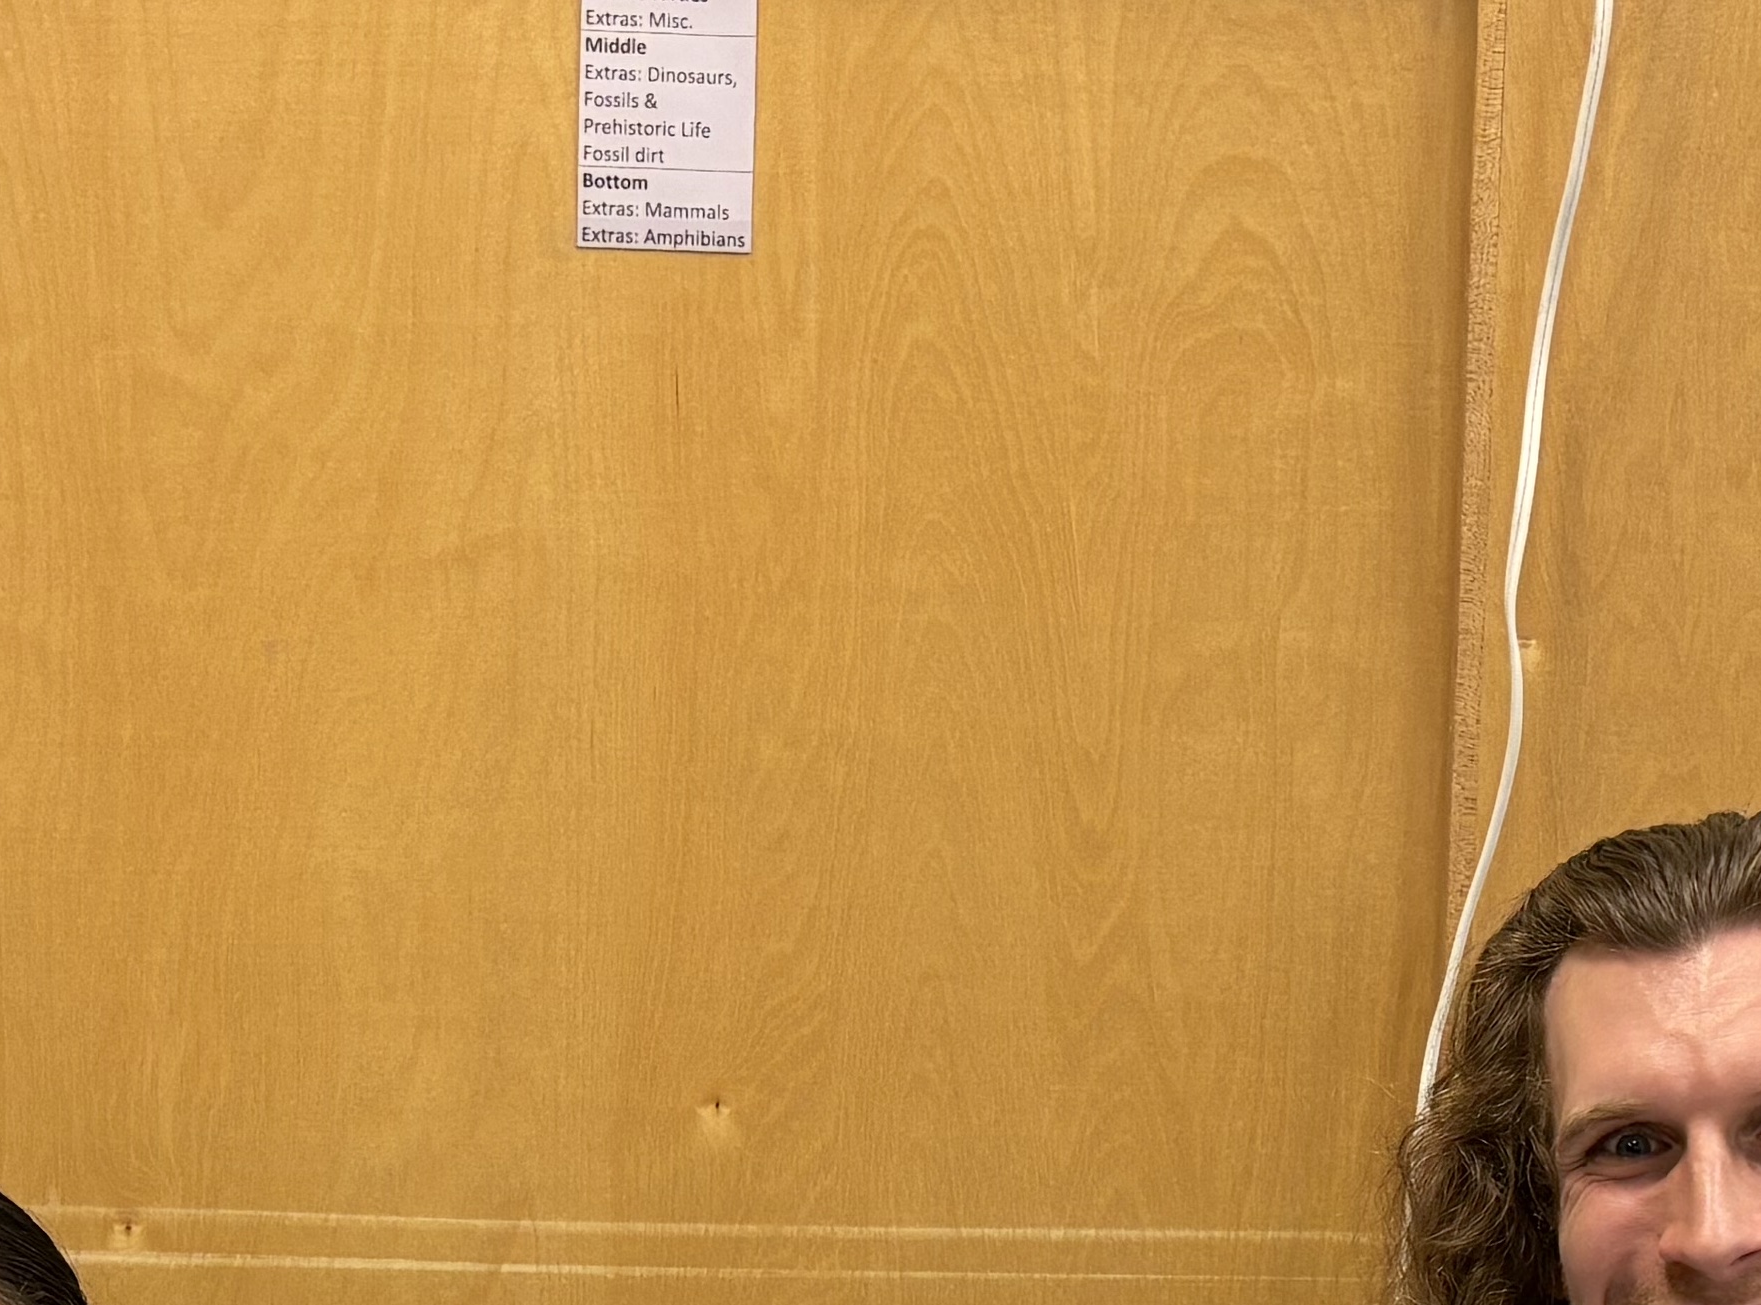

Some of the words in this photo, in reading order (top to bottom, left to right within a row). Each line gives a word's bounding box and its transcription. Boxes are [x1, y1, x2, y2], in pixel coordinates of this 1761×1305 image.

[585, 10, 643, 27] Extras:
[649, 12, 693, 29] Misc.
[585, 37, 647, 55] Middle
[584, 65, 642, 82] Extras:
[648, 67, 737, 88] Dinosaurs,
[584, 92, 639, 109] Fossils
[644, 93, 658, 109] &
[583, 118, 675, 137] Prehistoric
[681, 121, 711, 138] Life
[583, 145, 630, 162] Fossil
[635, 147, 665, 164] dirt
[582, 173, 648, 190] Bottom
[582, 200, 639, 217] Extras:
[645, 202, 729, 220] Mammals
[581, 227, 639, 244] Extras:
[644, 229, 746, 248] Amphibians
